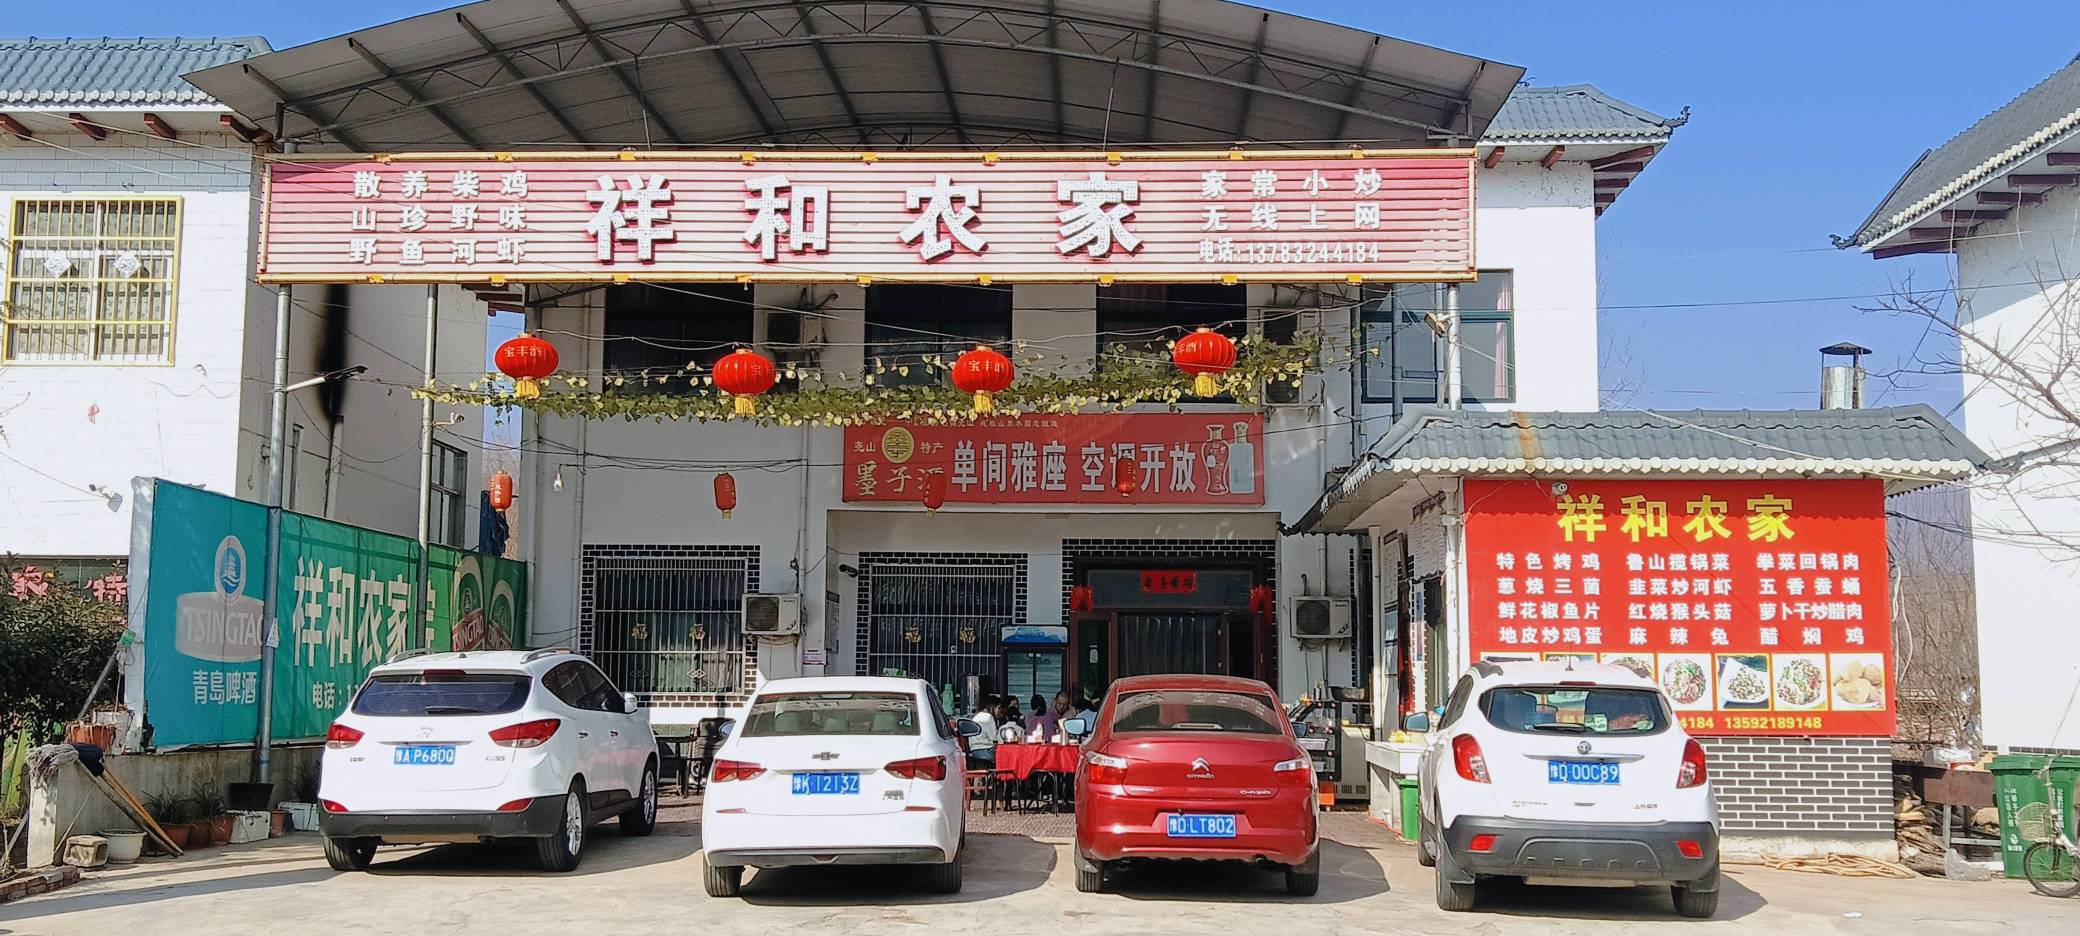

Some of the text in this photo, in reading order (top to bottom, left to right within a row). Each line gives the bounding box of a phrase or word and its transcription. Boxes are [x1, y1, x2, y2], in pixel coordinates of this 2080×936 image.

[352, 171, 528, 199] 散养柴鸡
[1201, 169, 1382, 197] 家常小炒
[351, 205, 528, 231] 山珍野味
[586, 172, 1142, 261] 祥和农家
[1203, 203, 1381, 231] 无线上网
[349, 238, 527, 265] 野鱼河虾
[920, 442, 944, 454] 特产
[952, 441, 1067, 492] 单间雅座
[1557, 494, 1795, 542] 祥和农家
[1496, 552, 1600, 570] 特色烤鸡
[1628, 578, 1732, 595] 韭菜炒河虾
[1759, 577, 1861, 595] 五香蚕蛹
[1498, 601, 1863, 620] 鲜花椒鱼片 红烧猴头菇 萝卜干炒腊肉
[1499, 626, 1864, 645] 地皮炒鸡蛋 麻辣兔 醋焖鸡
[193, 669, 257, 705] 青岛啤酒
[1724, 716, 1823, 729] 13592189148
